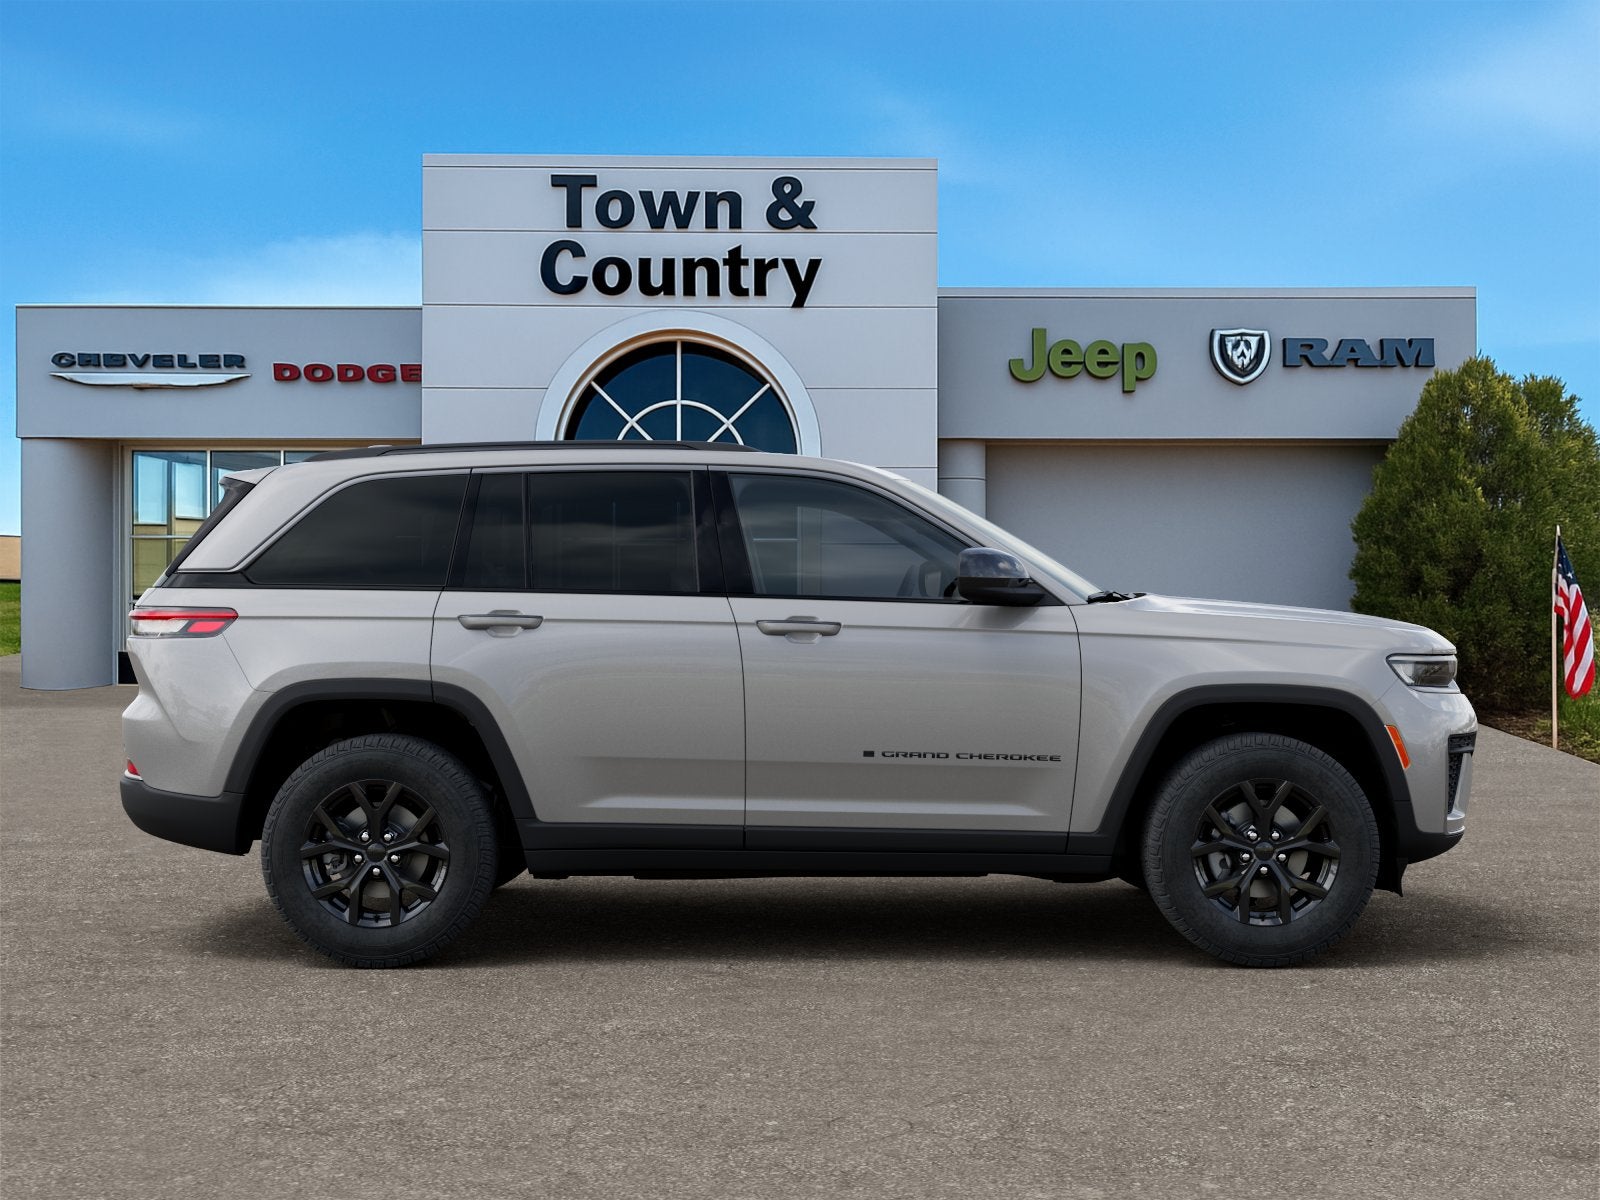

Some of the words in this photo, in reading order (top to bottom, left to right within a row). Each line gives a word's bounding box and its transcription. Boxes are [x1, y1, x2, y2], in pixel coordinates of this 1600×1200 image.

[551, 174, 742, 230] Town
[766, 176, 818, 230] &
[540, 239, 822, 308] Country
[273, 362, 422, 383] DODGE
[1009, 328, 1158, 393] Jeep
[1283, 338, 1436, 367] RAM
[881, 750, 950, 759] GRAND
[955, 752, 1062, 762] CHEROKEE
